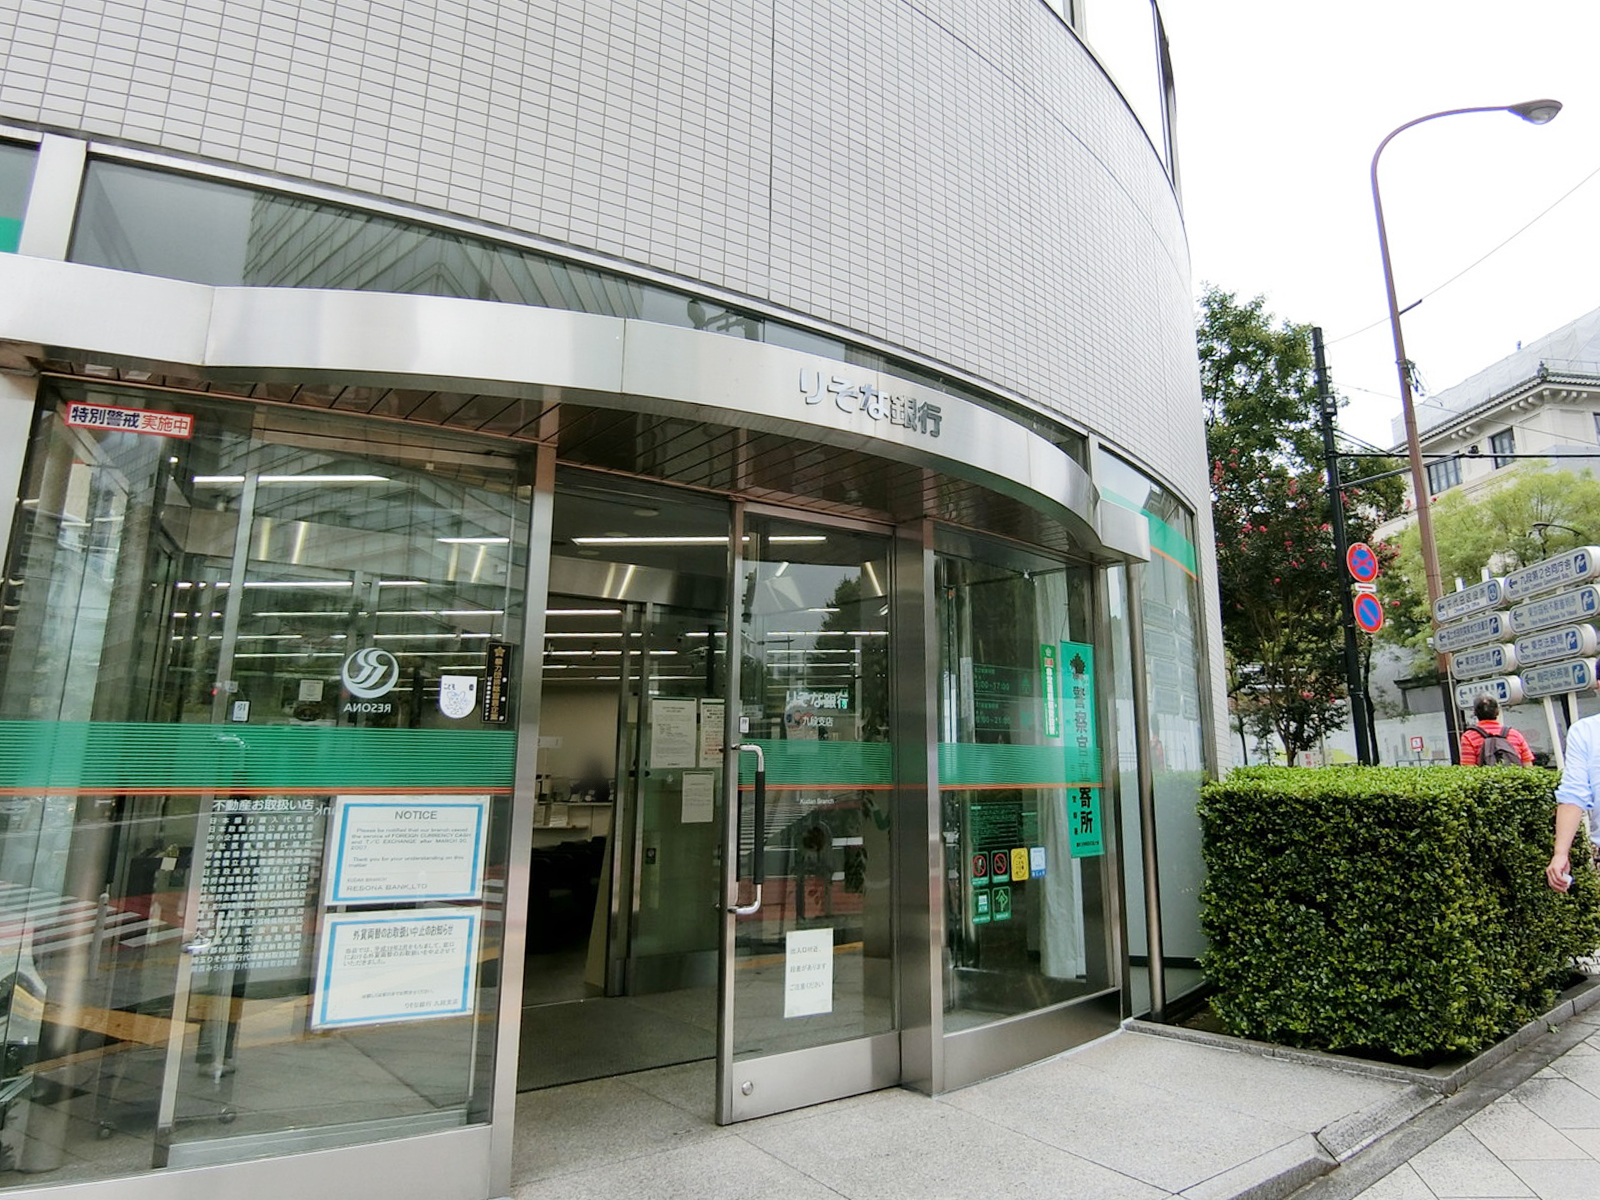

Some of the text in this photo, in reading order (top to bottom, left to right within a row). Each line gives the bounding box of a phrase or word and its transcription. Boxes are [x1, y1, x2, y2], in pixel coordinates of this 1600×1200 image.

[799, 368, 943, 437] りそな銀行
[71, 406, 188, 434] 特別警戒実施中
[803, 716, 833, 726] 九段支店
[212, 799, 315, 812] 不動産お取扱い店
[209, 816, 314, 824] 日本銀行歳入代理店
[394, 810, 438, 820] NOTICE
[208, 824, 314, 833] 日本政策金融公庫代理店
[346, 884, 382, 892] RESONA
[353, 924, 454, 940] 外貨両替のお取扱い中止のお知らせ
